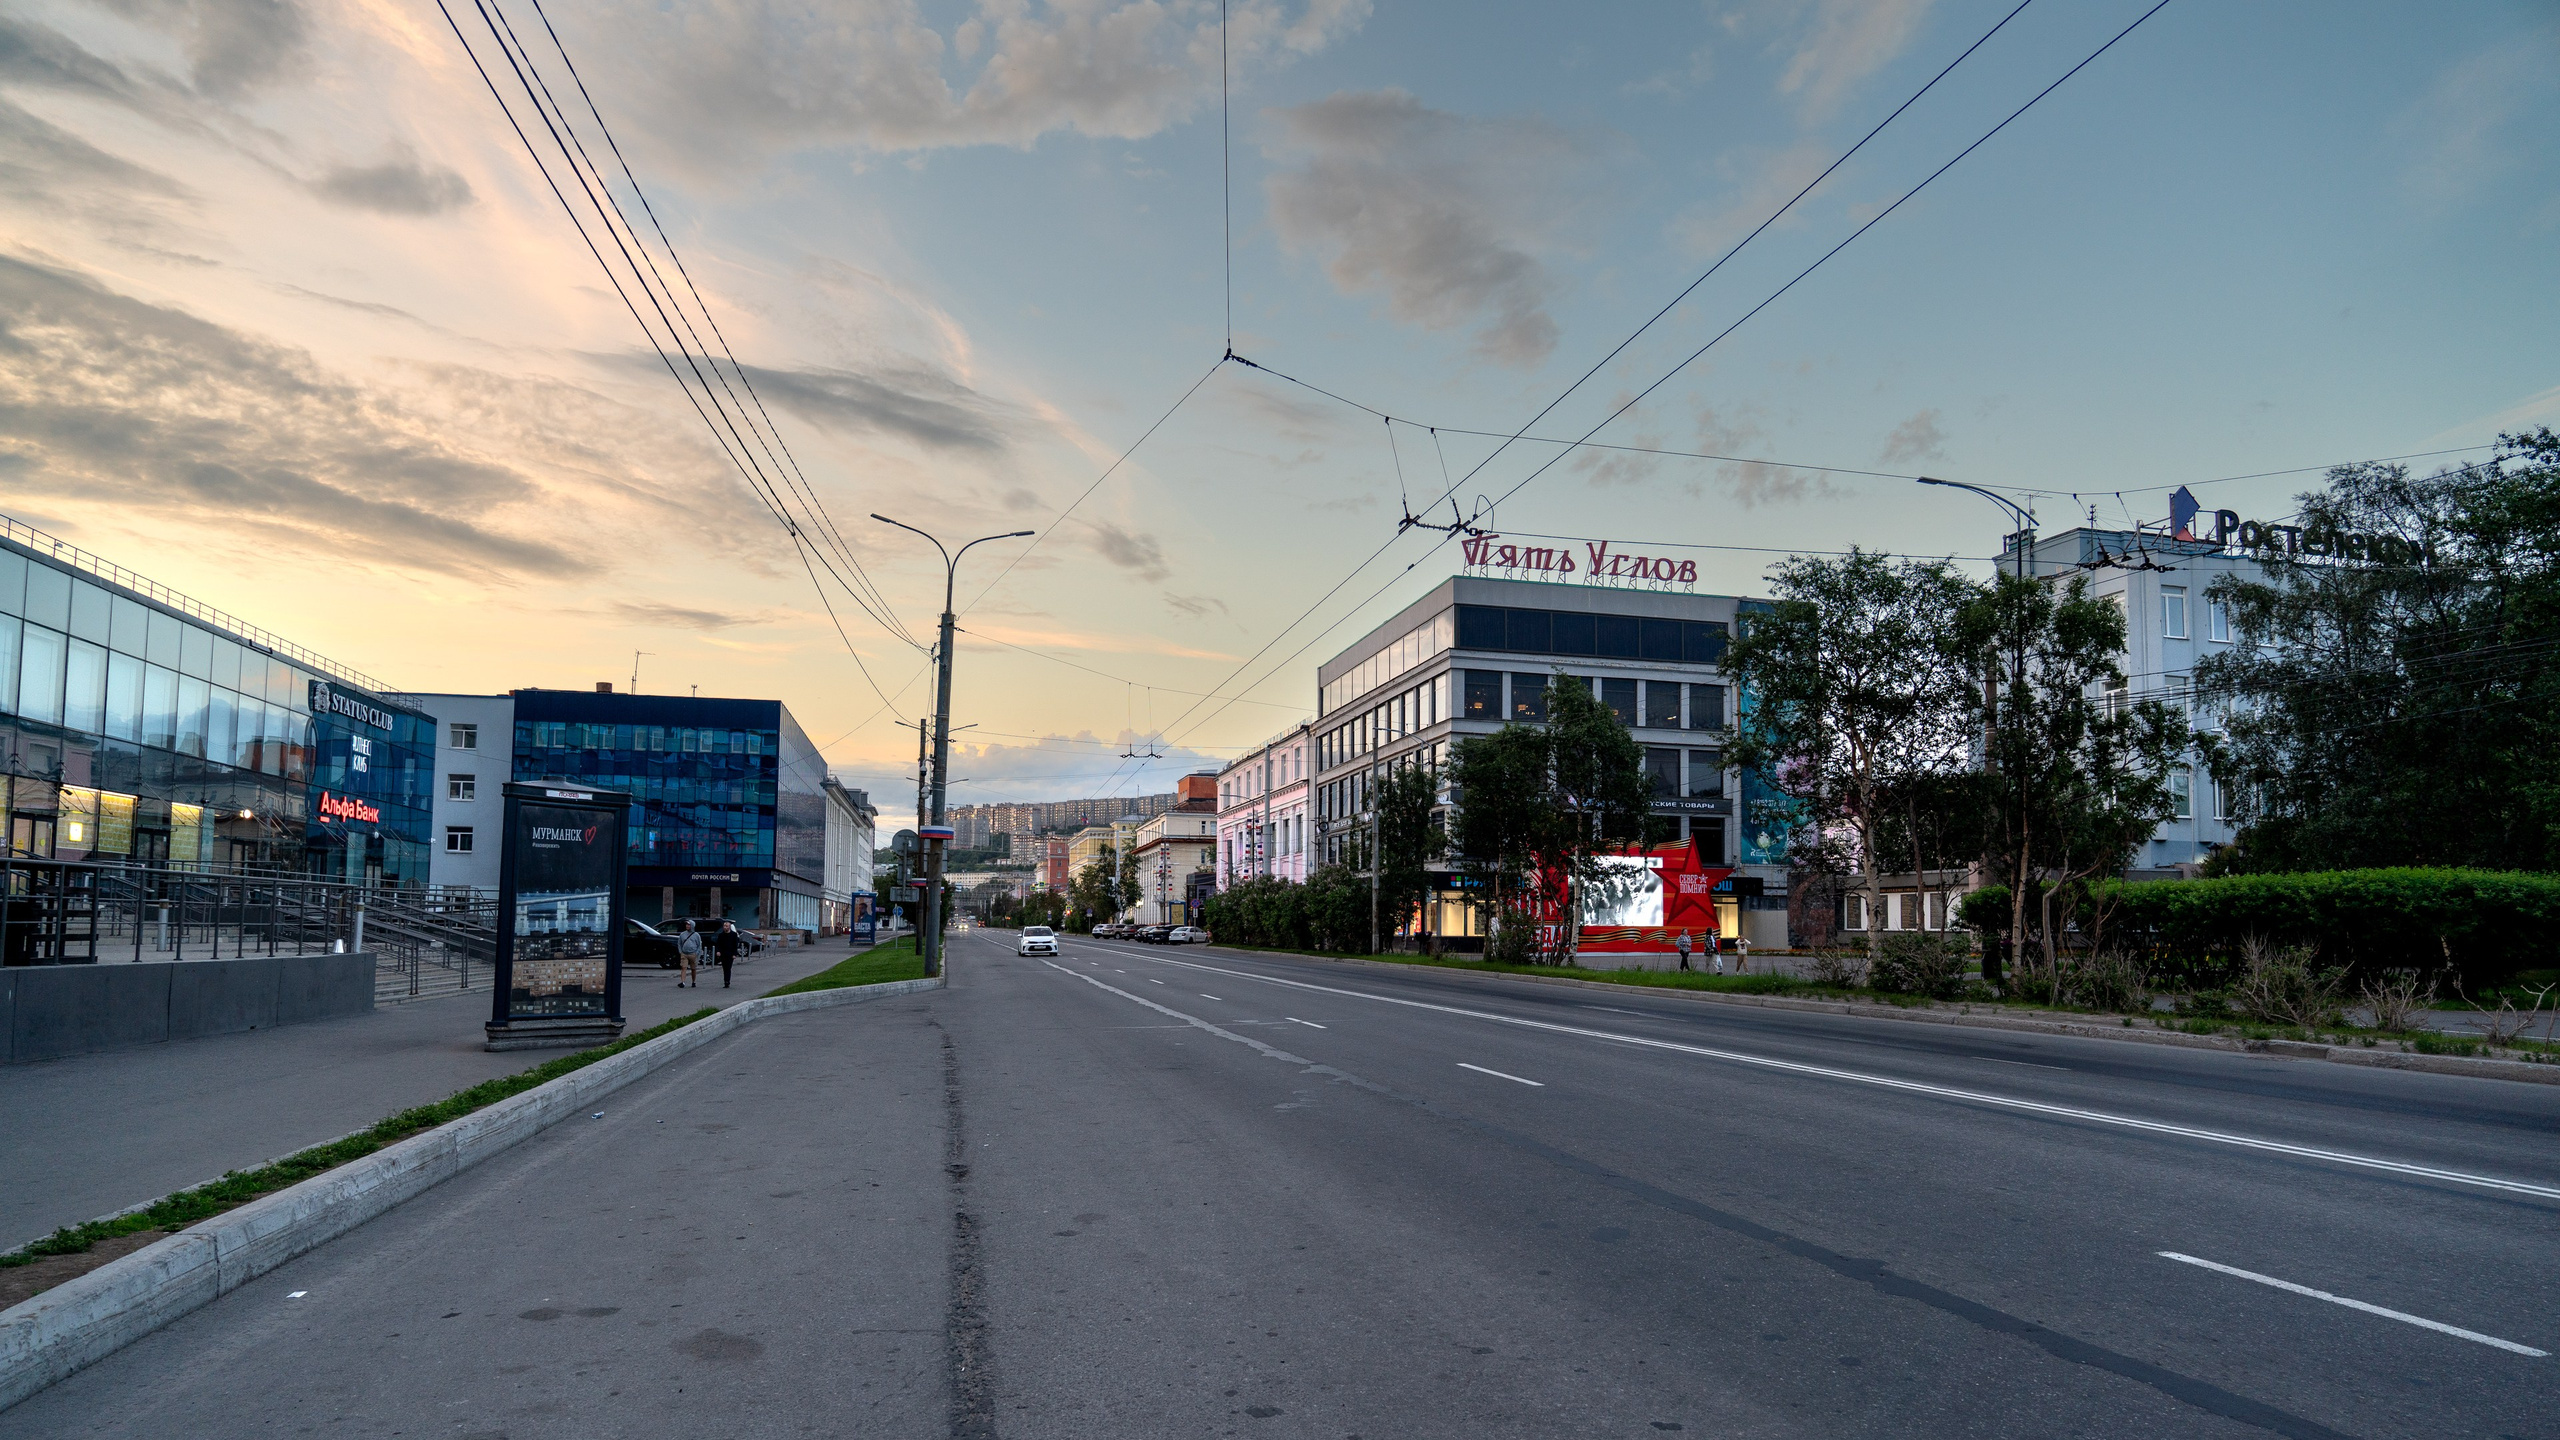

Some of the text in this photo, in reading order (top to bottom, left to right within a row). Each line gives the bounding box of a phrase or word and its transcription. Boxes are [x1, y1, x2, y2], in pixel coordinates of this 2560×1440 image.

[1461, 533, 1698, 582] Пять Углов
[332, 693, 393, 731] STATUS CLUB
[353, 754, 367, 773] КЛУБ
[320, 791, 379, 823] Альфа Банк
[532, 827, 582, 841] МУРМАНСК
[1679, 874, 1699, 884] СЕВЕР
[1679, 883, 1707, 894] ПОМНИТ
